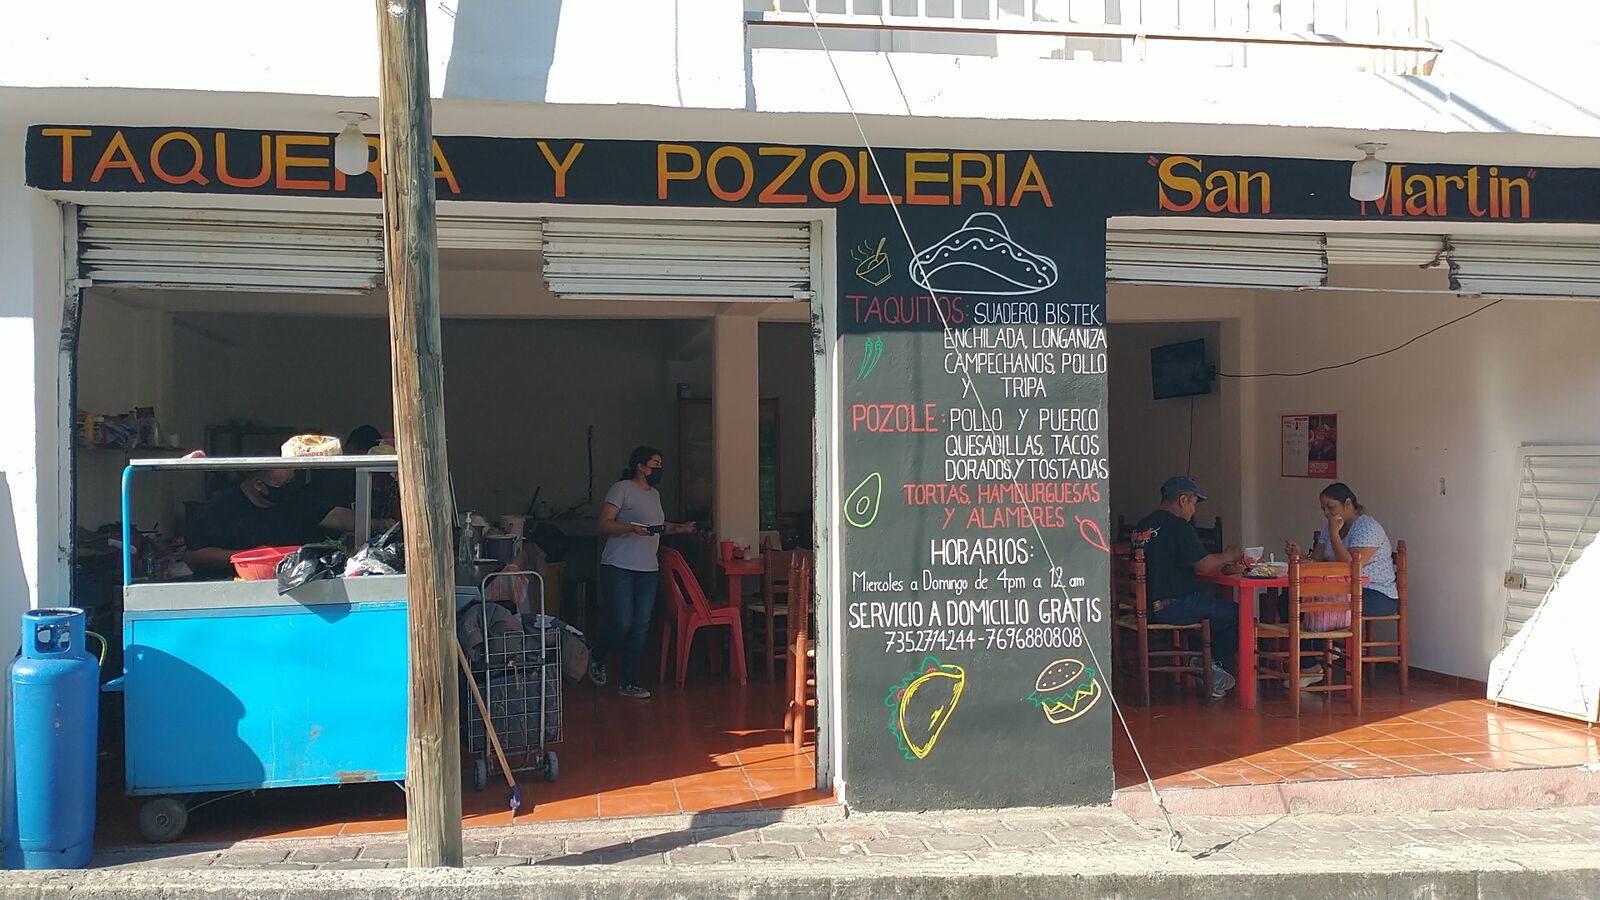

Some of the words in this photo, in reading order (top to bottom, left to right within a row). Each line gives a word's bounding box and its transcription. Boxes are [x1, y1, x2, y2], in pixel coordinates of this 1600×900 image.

[537, 141, 585, 198] Y
[657, 143, 1054, 208] POZOLERIA
[847, 294, 971, 324] TAQUITOS:
[1033, 328, 1108, 349] LONGANIZA
[1061, 353, 1107, 374] POLLO
[1001, 377, 1047, 398] TRIPA
[950, 408, 1003, 431] POLLO
[1039, 409, 1098, 431] PUERCO
[1051, 434, 1100, 455] TACOS
[945, 459, 1012, 481] DORADOS
[1027, 459, 1109, 480] TOSTADAS
[978, 483, 1101, 505] HAMBURGUESAS
[966, 506, 1065, 529] ALAMBRES
[930, 538, 1035, 566] HORARIOS:
[852, 571, 904, 593] Miercoles
[910, 580, 919, 592] a
[922, 569, 968, 596] Domingo
[974, 568, 989, 590] de
[996, 568, 1026, 593] 4pm
[1032, 577, 1042, 589] a
[1048, 567, 1066, 589] 12
[1068, 577, 1085, 588] am
[848, 602, 924, 629] SERVICIO
[928, 602, 942, 627] A
[946, 599, 1029, 627] DOMICILIO
[1038, 597, 1102, 624] GRATIS
